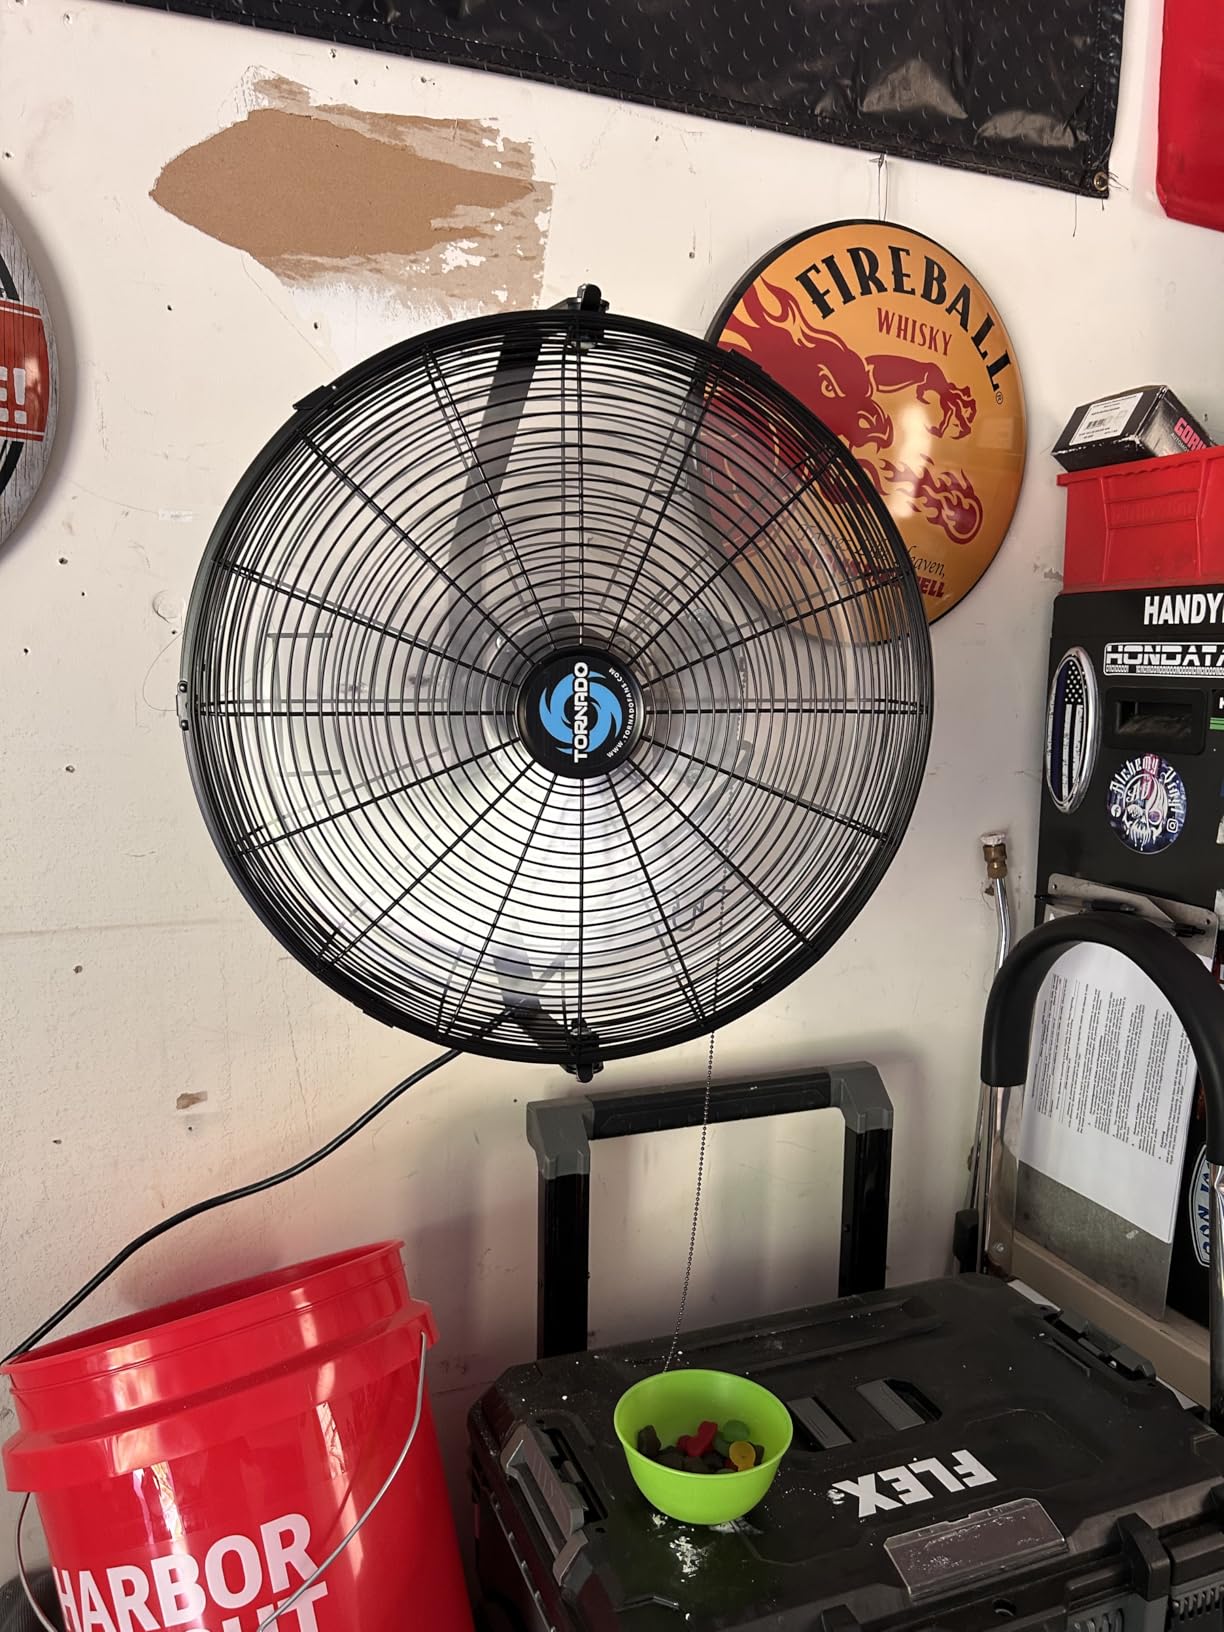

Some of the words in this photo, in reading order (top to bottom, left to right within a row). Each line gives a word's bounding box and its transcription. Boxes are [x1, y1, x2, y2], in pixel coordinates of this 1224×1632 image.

[876, 307, 953, 357] WHISKY
[574, 661, 589, 764] TORNADO
[1109, 755, 1159, 795] Alchemy
[832, 1448, 998, 1518] FLEX
[53, 1512, 320, 1632] HARBOR
